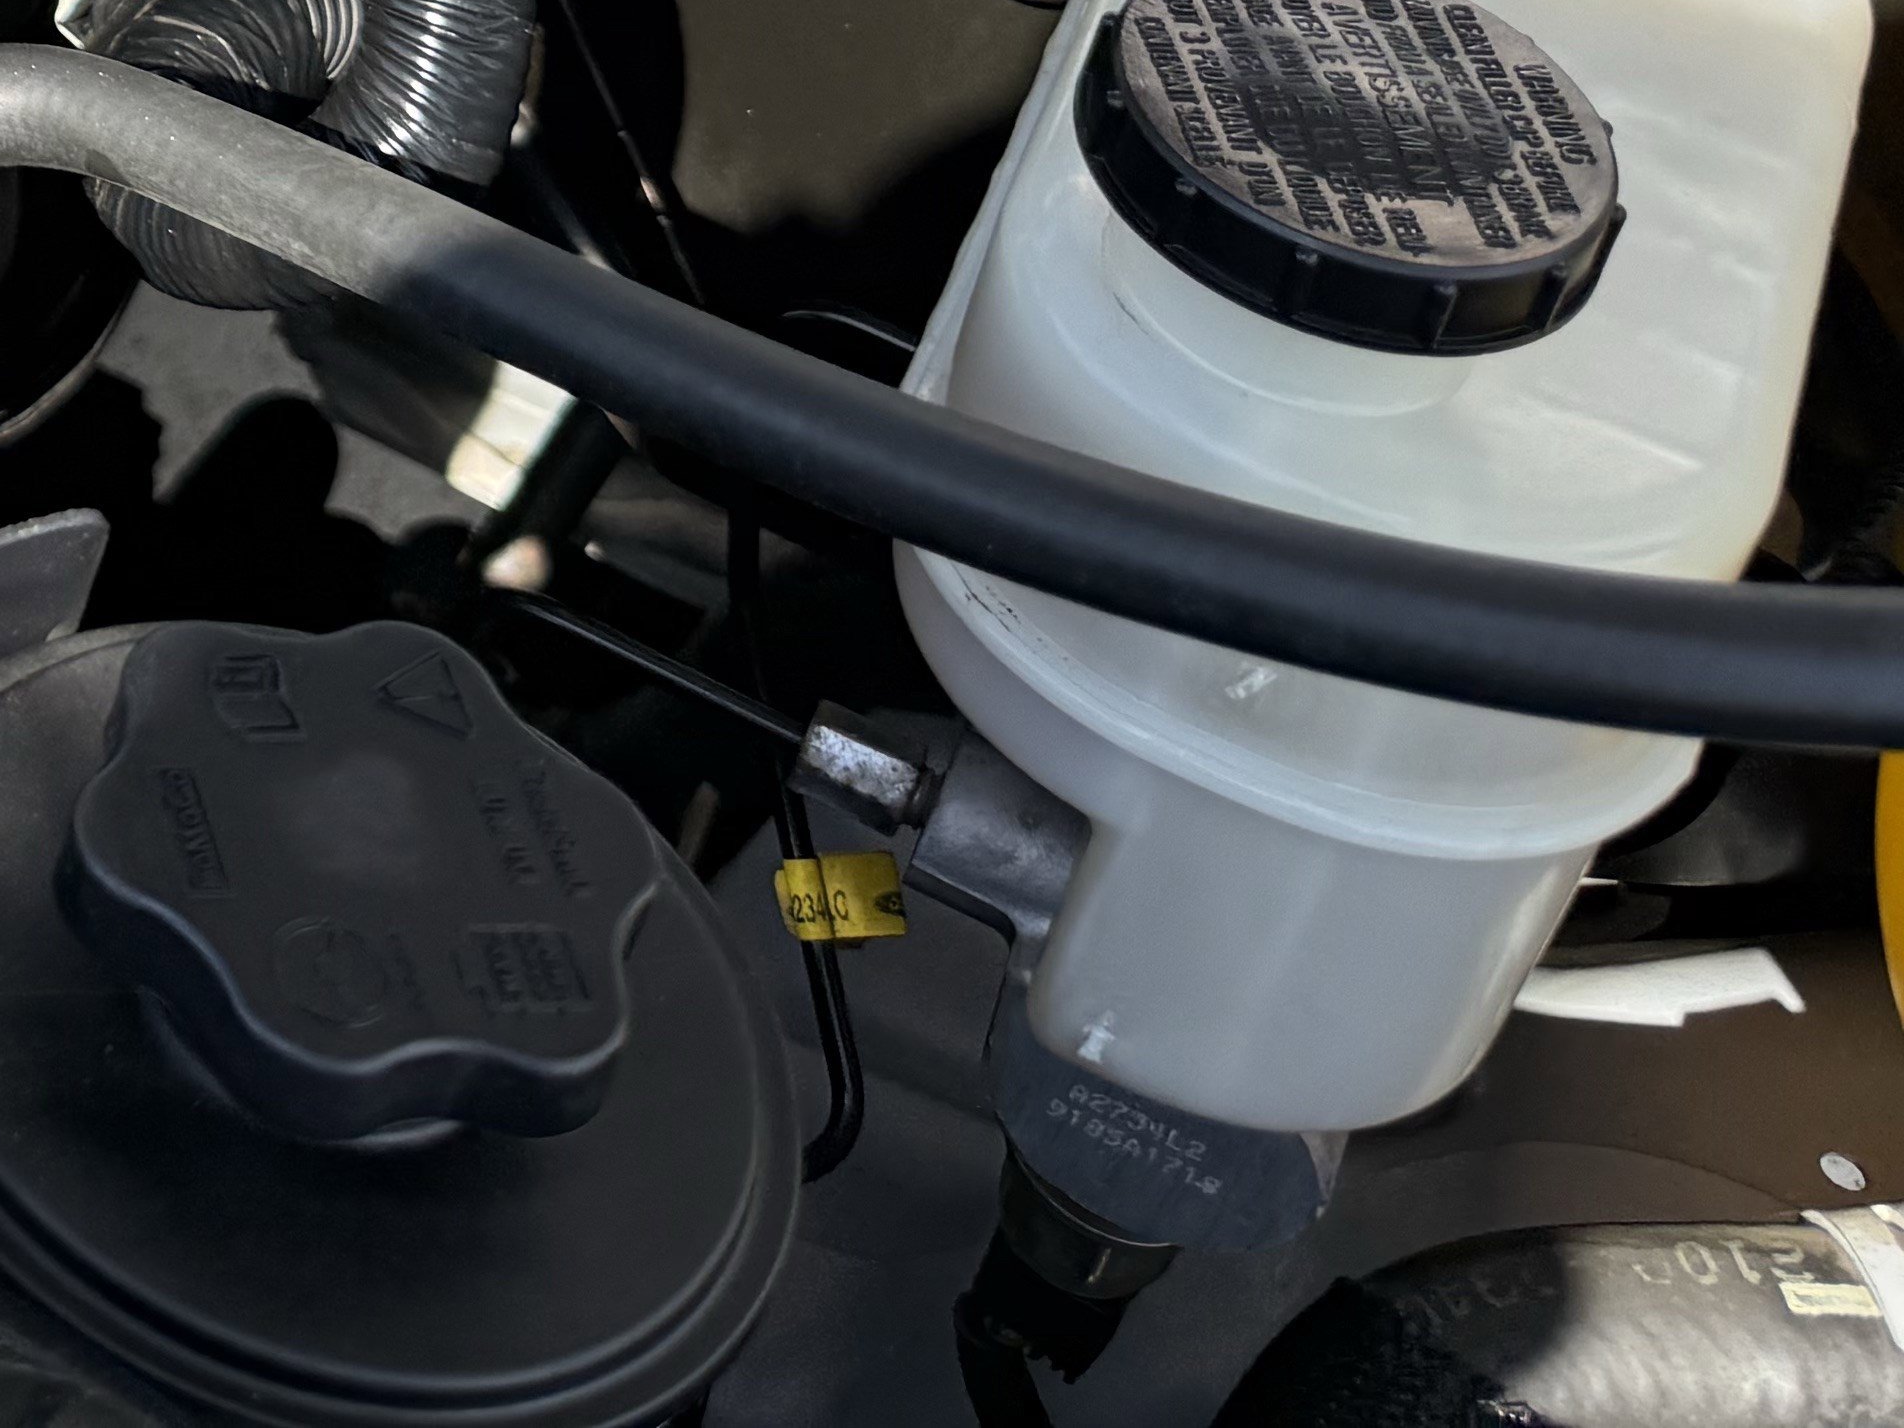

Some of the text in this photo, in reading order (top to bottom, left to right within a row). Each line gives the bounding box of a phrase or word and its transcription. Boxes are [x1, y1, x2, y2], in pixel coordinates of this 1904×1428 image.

[1441, 3, 1496, 55] CLEAN
[1186, 48, 1269, 154] PROVENANT
[1322, 2, 1461, 206] AVERTISSEMENT
[1323, 70, 1397, 163] BOUCHON
[1410, 78, 1470, 143] SEALED
[1513, 63, 1599, 166] WARNING
